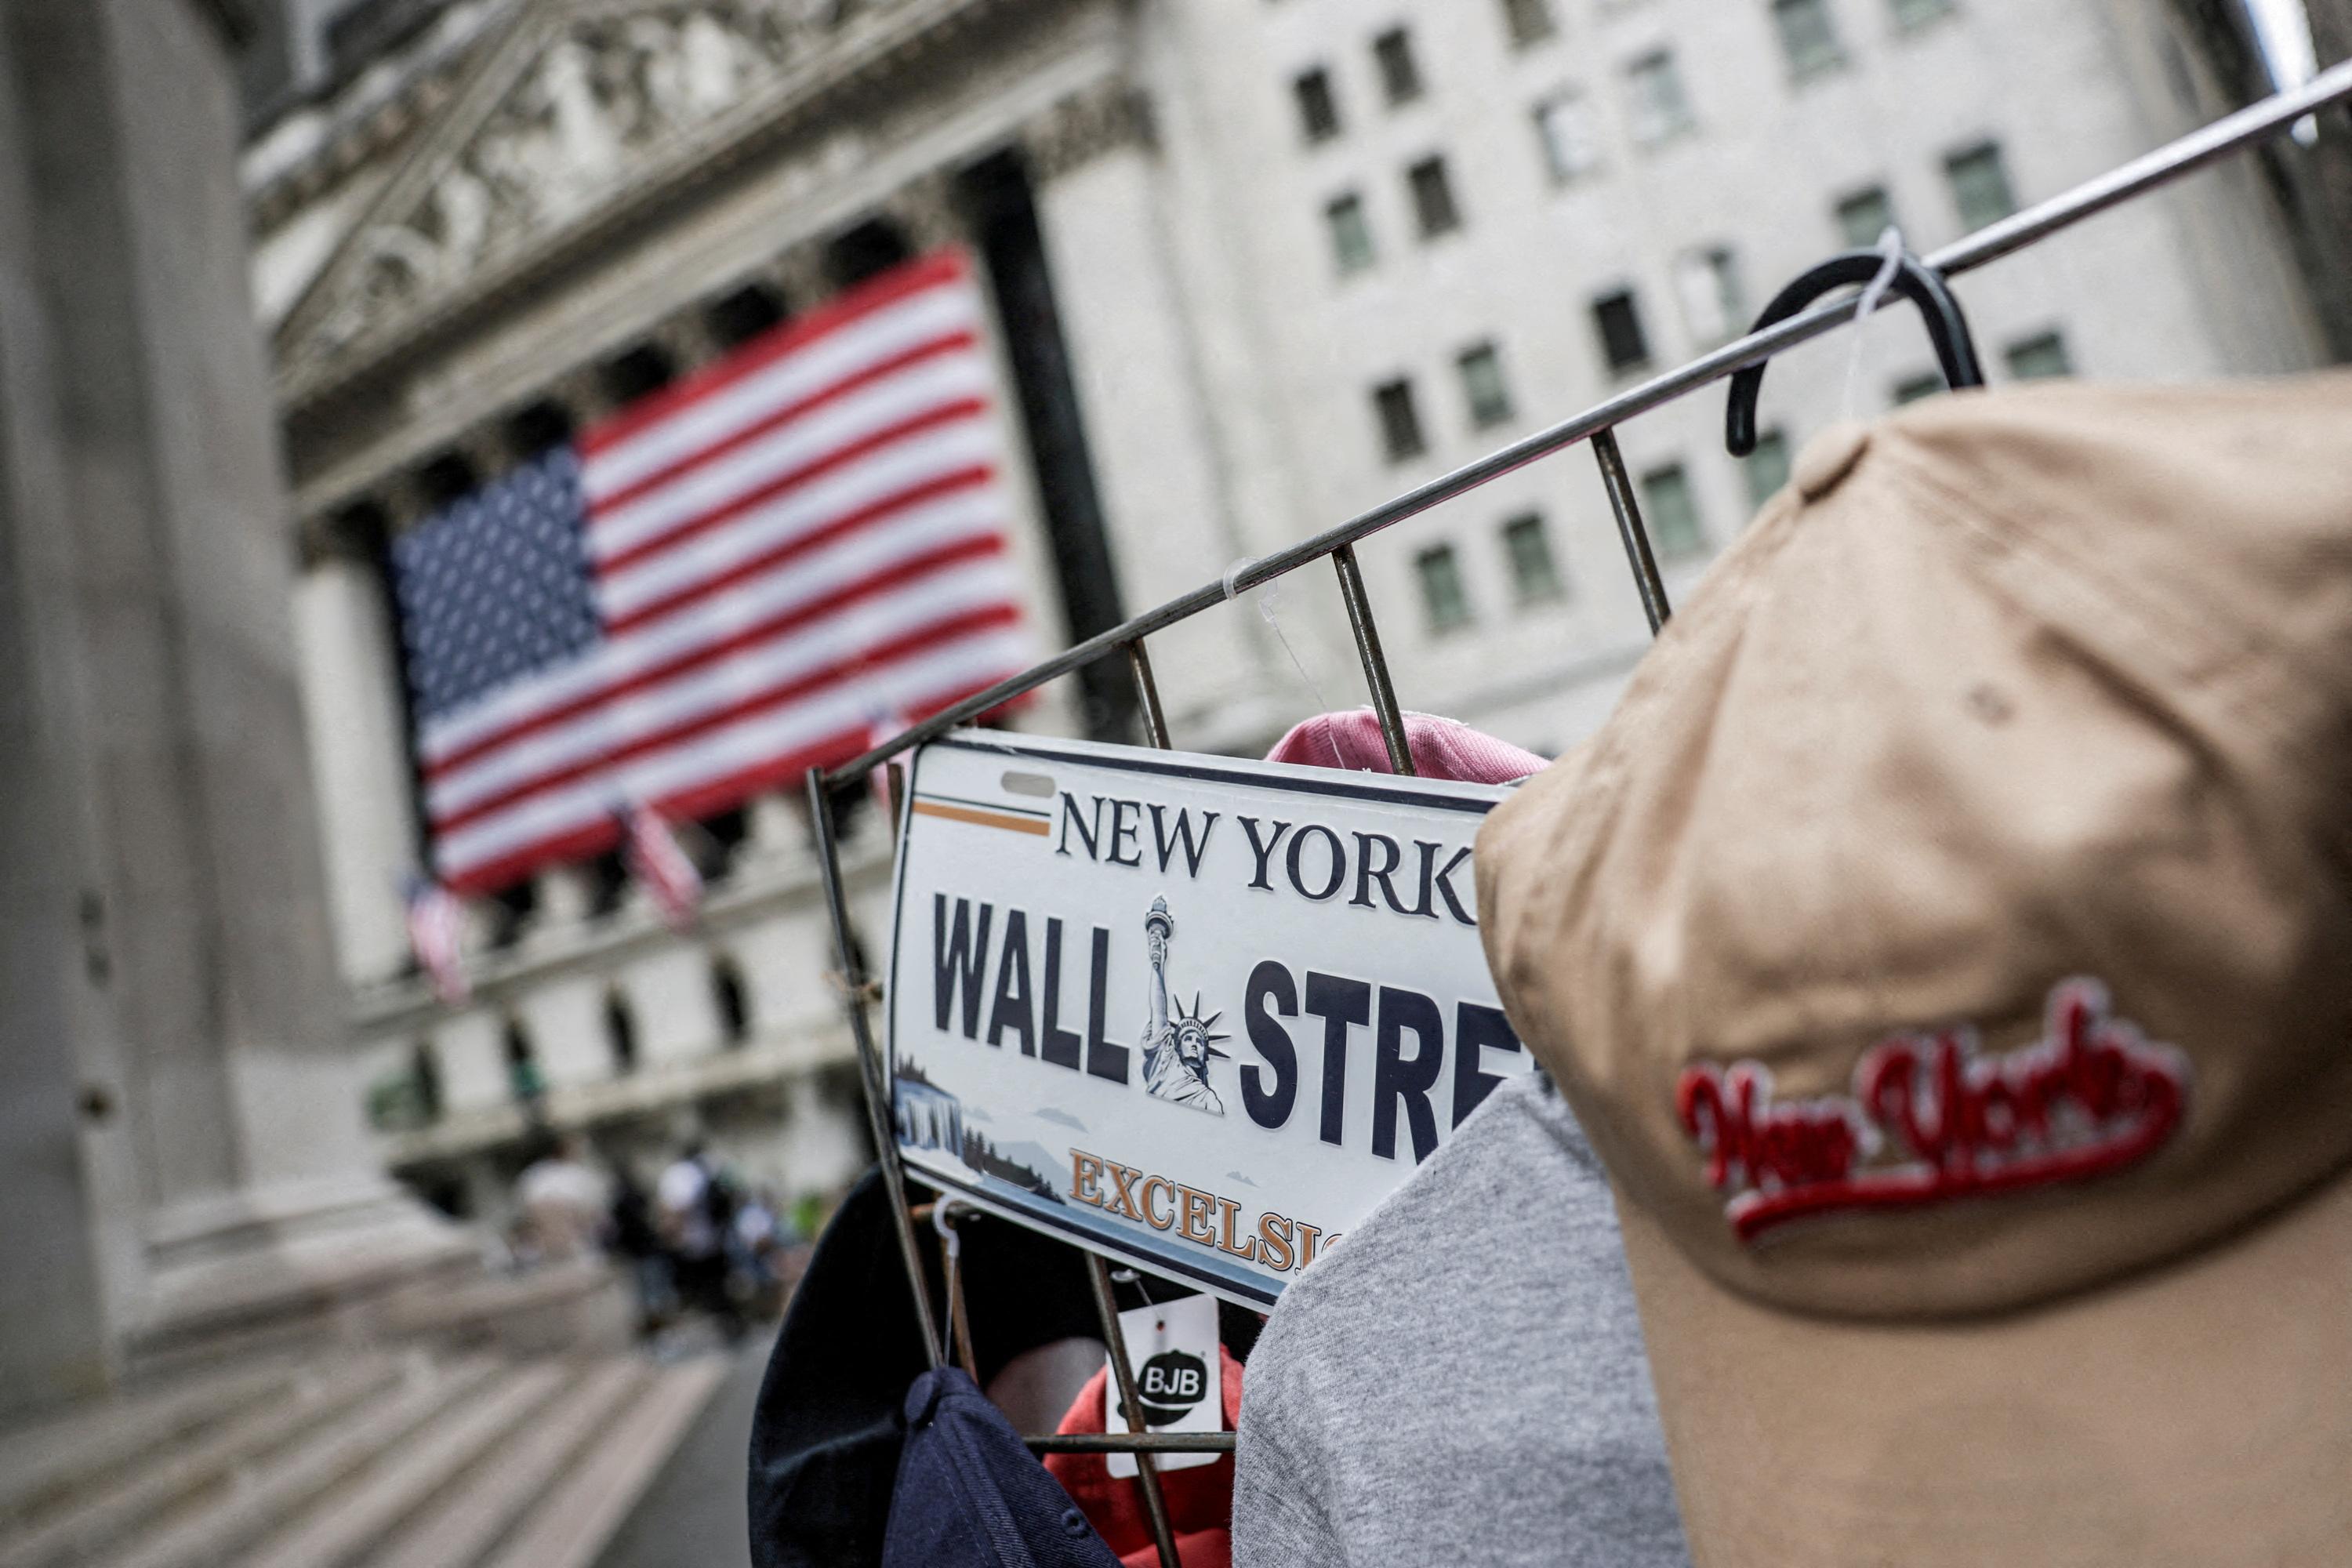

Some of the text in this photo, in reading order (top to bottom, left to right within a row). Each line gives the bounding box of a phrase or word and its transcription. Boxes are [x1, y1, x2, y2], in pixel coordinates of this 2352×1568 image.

[1055, 791, 1477, 926] NEW YORK
[935, 892, 1546, 1167] WALL STRE
[1068, 1147, 1343, 1276] EXCELSI
[1145, 1367, 1200, 1397] BJB
